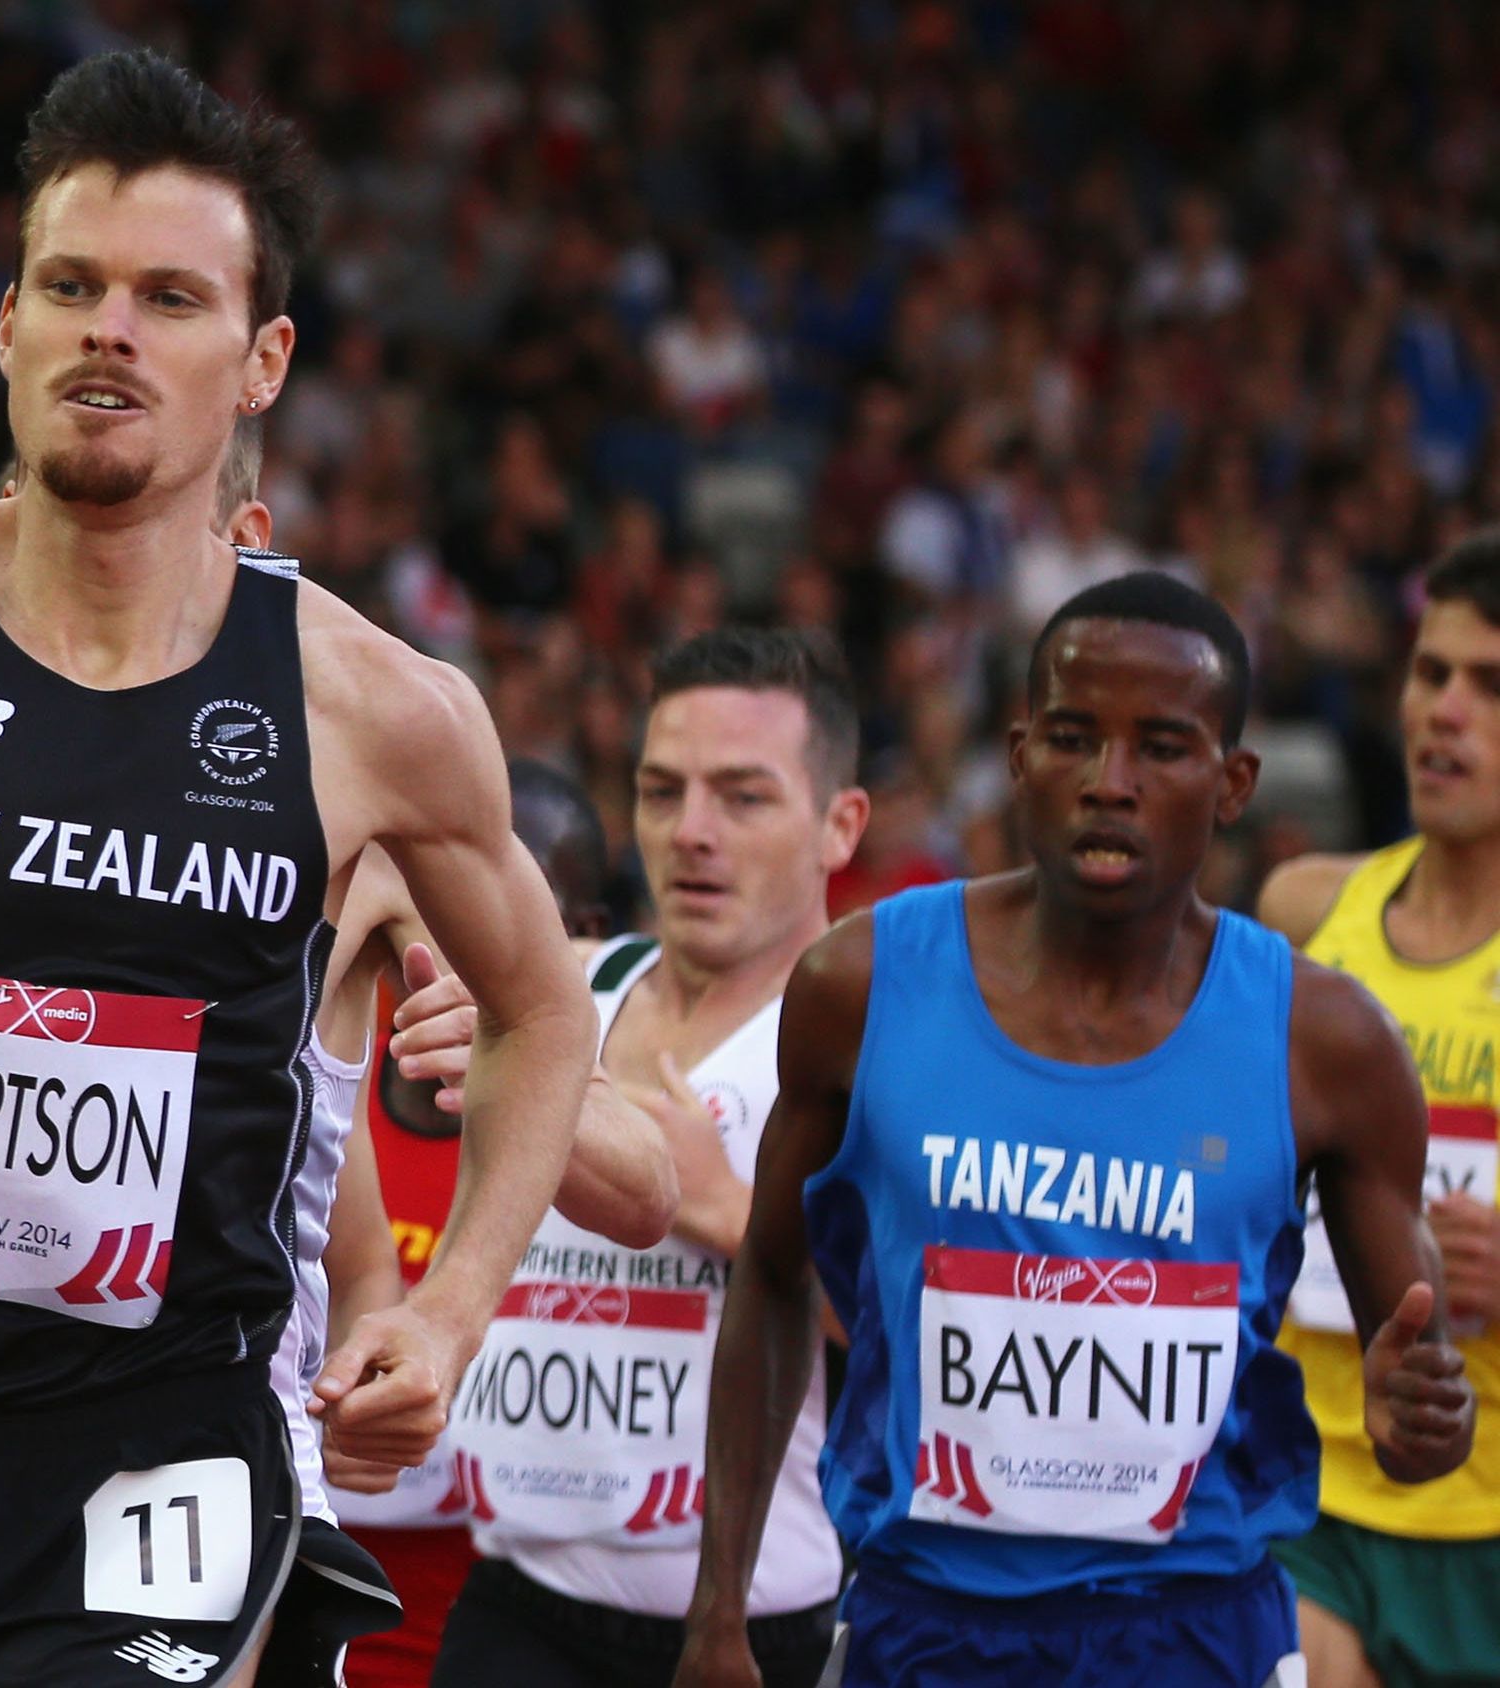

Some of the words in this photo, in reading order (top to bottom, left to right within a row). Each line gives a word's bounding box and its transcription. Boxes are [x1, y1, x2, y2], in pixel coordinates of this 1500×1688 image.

[190, 699, 262, 748] COMMONWEALTH
[262, 716, 279, 759] GAMES
[200, 759, 220, 779] NEW
[221, 767, 267, 785] ZEALAND
[185, 791, 248, 808] GLASGOW
[250, 800, 275, 812] 2014
[9, 815, 298, 922] ZEALAND
[43, 1006, 88, 1022] media
[922, 1134, 1195, 1245] TANZANIA
[10, 1241, 48, 1258] GAMES
[15, 1221, 72, 1250] 2014
[1025, 1255, 1087, 1304] Virgin
[1113, 1276, 1151, 1291] media
[464, 1346, 690, 1437] MOONEY
[941, 1325, 1223, 1424] BAYNIT
[990, 1455, 1105, 1480] GLASGOW
[1114, 1465, 1158, 1483] 2014
[121, 1495, 203, 1585] 11
